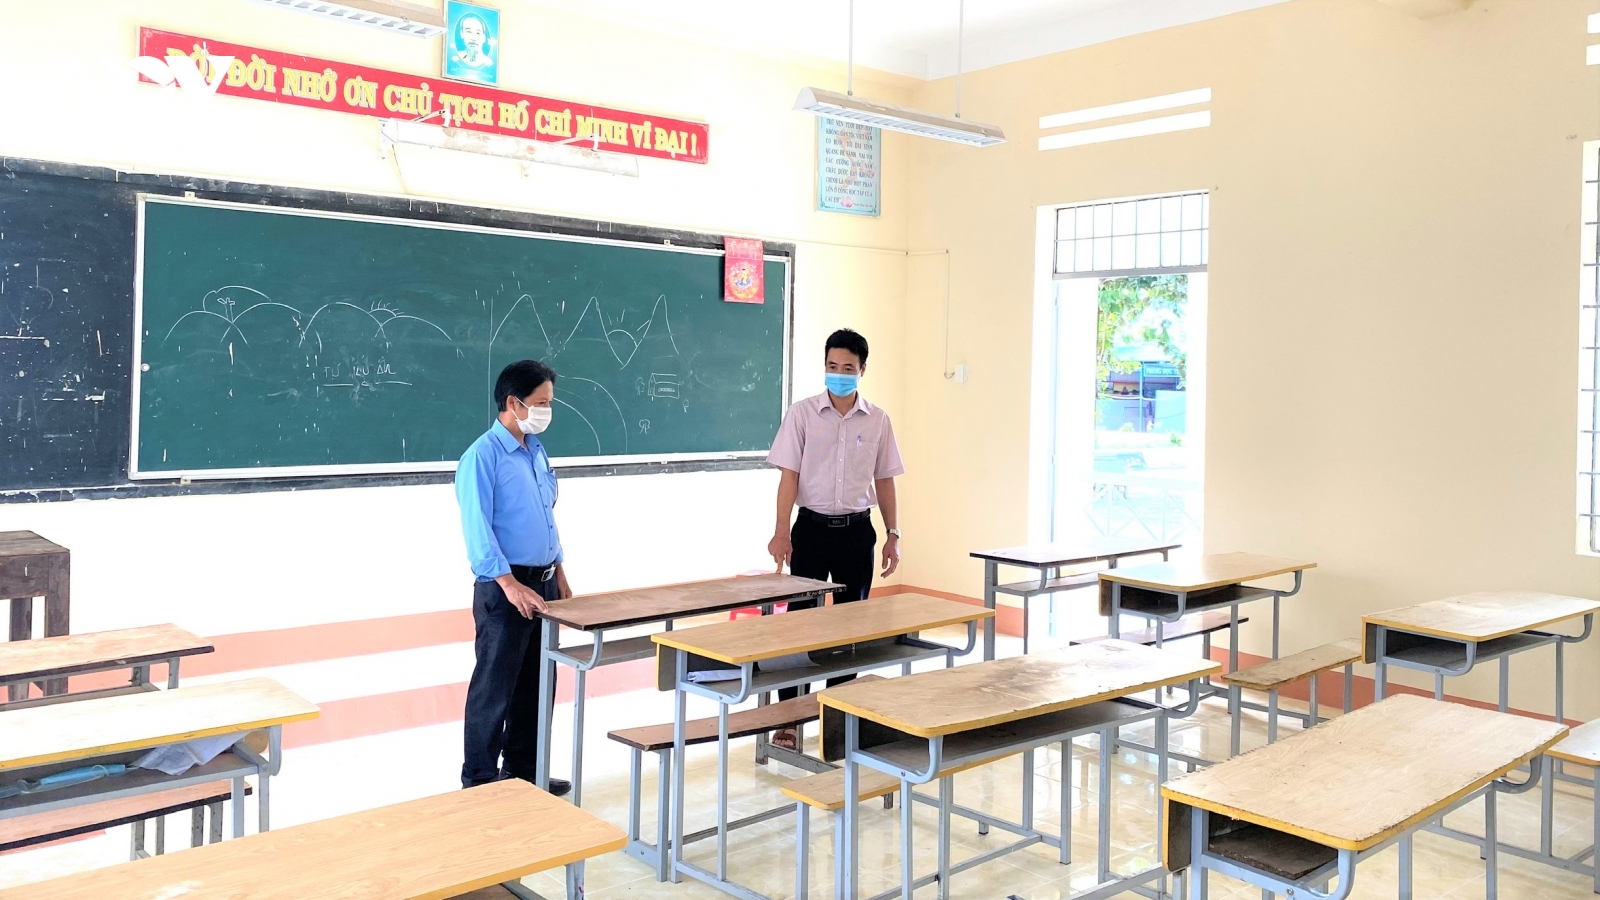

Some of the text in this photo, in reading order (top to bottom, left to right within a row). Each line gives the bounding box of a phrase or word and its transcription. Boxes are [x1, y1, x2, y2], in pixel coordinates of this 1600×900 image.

[226, 53, 277, 93] ĐỜI
[282, 67, 338, 102] NHỚ
[343, 75, 378, 109] ƠN
[383, 82, 433, 116] CHỦ
[439, 92, 494, 127] TỊCH
[498, 99, 531, 131] HỒ
[535, 108, 572, 137] CHÍ
[575, 114, 629, 146] MINH
[654, 127, 688, 158] ĐẠI
